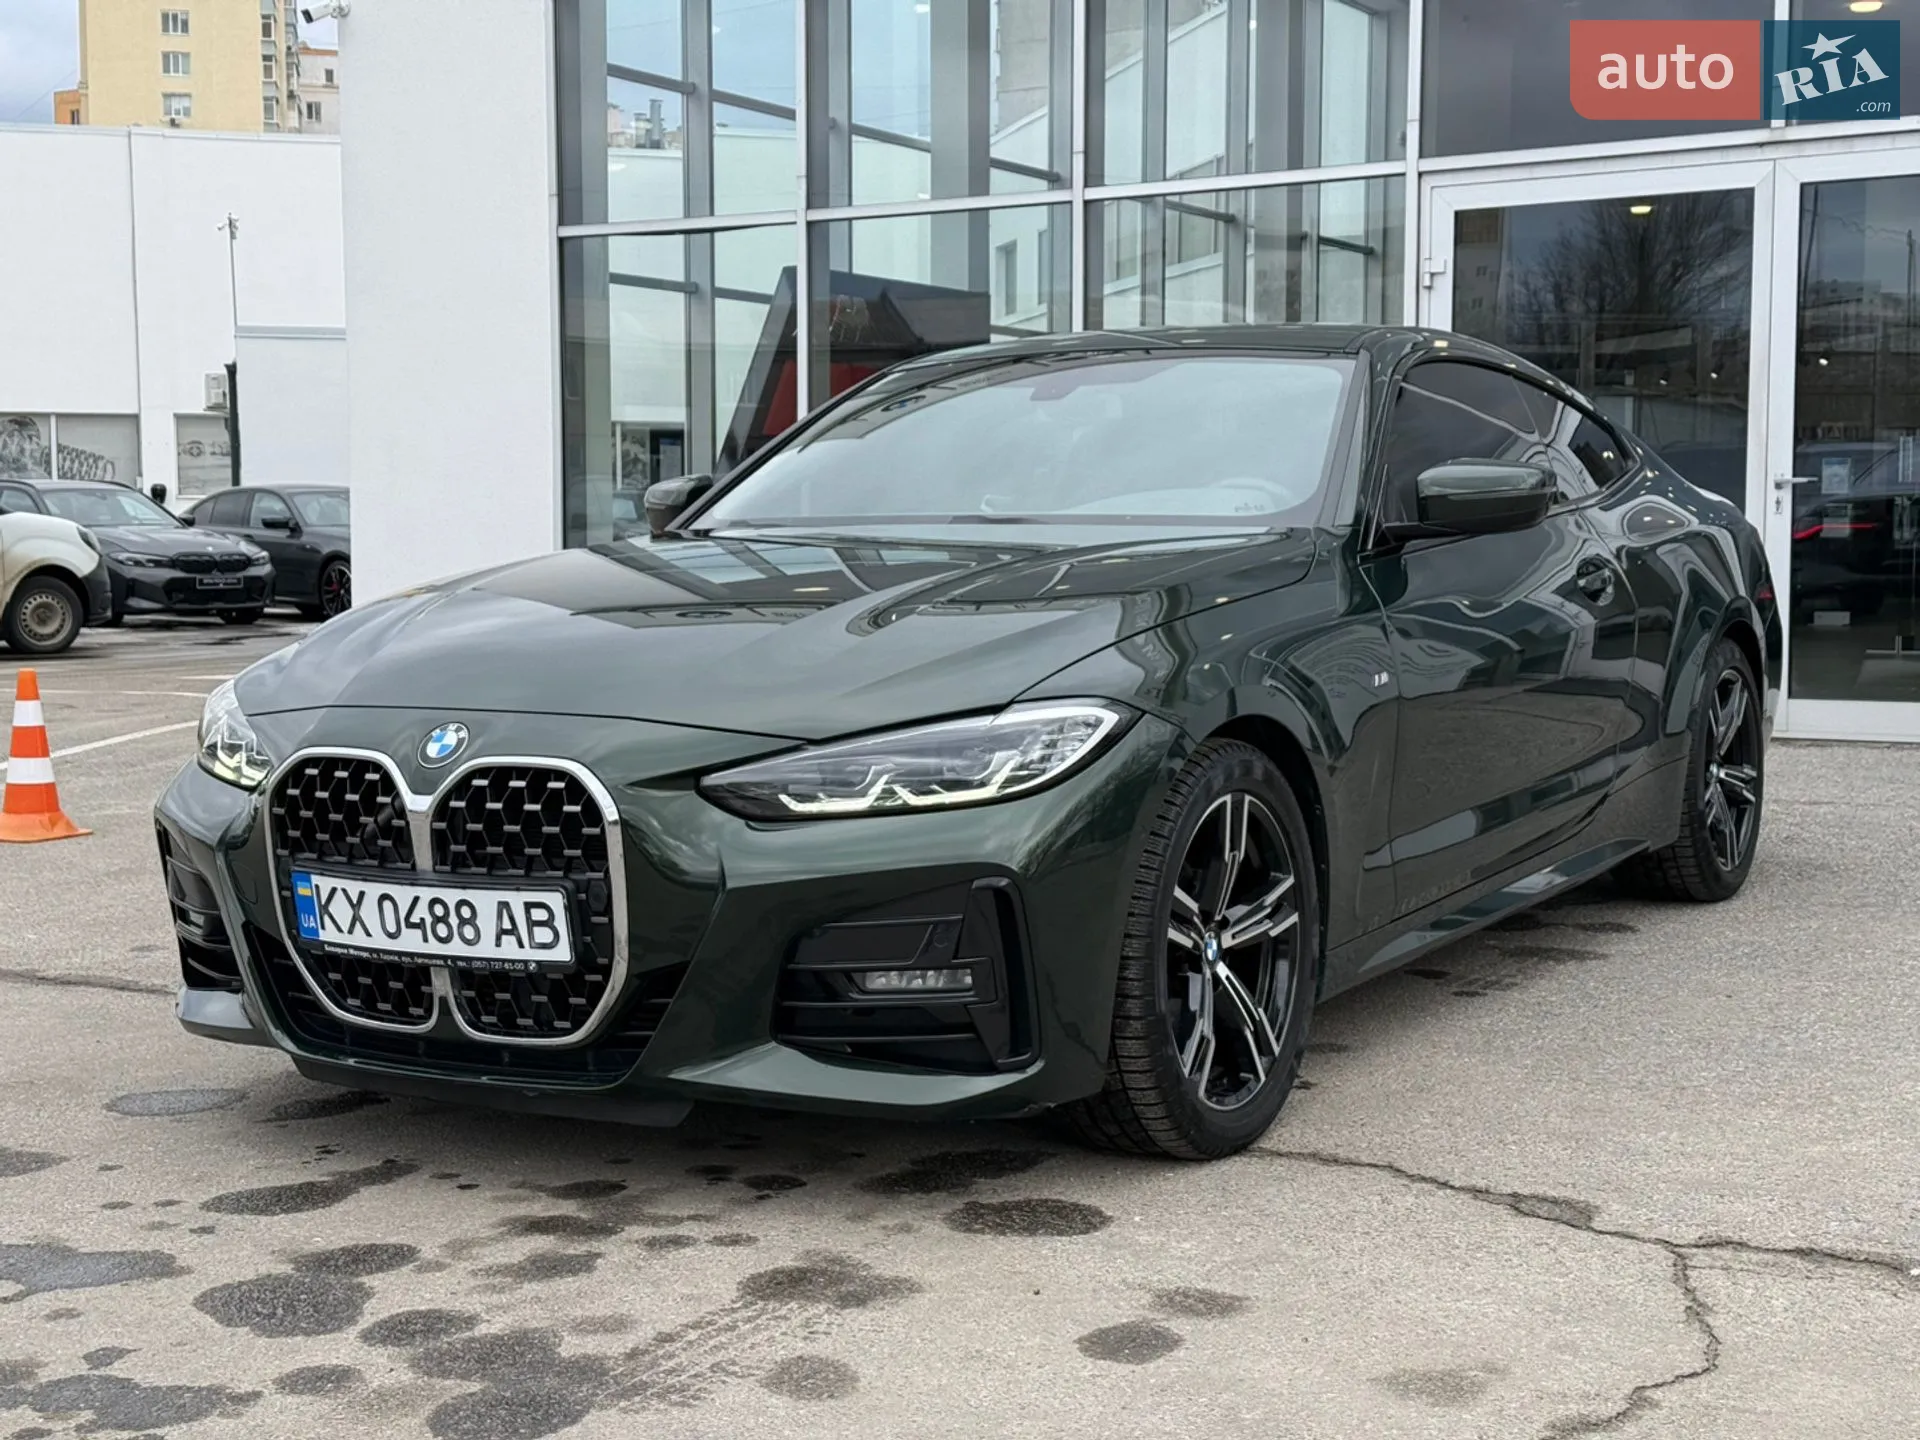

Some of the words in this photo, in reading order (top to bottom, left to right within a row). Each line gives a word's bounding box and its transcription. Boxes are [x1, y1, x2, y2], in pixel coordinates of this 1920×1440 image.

[301, 914, 317, 930] UA
[314, 883, 373, 938] KX
[377, 892, 482, 947] 0488
[494, 900, 561, 951] AB
